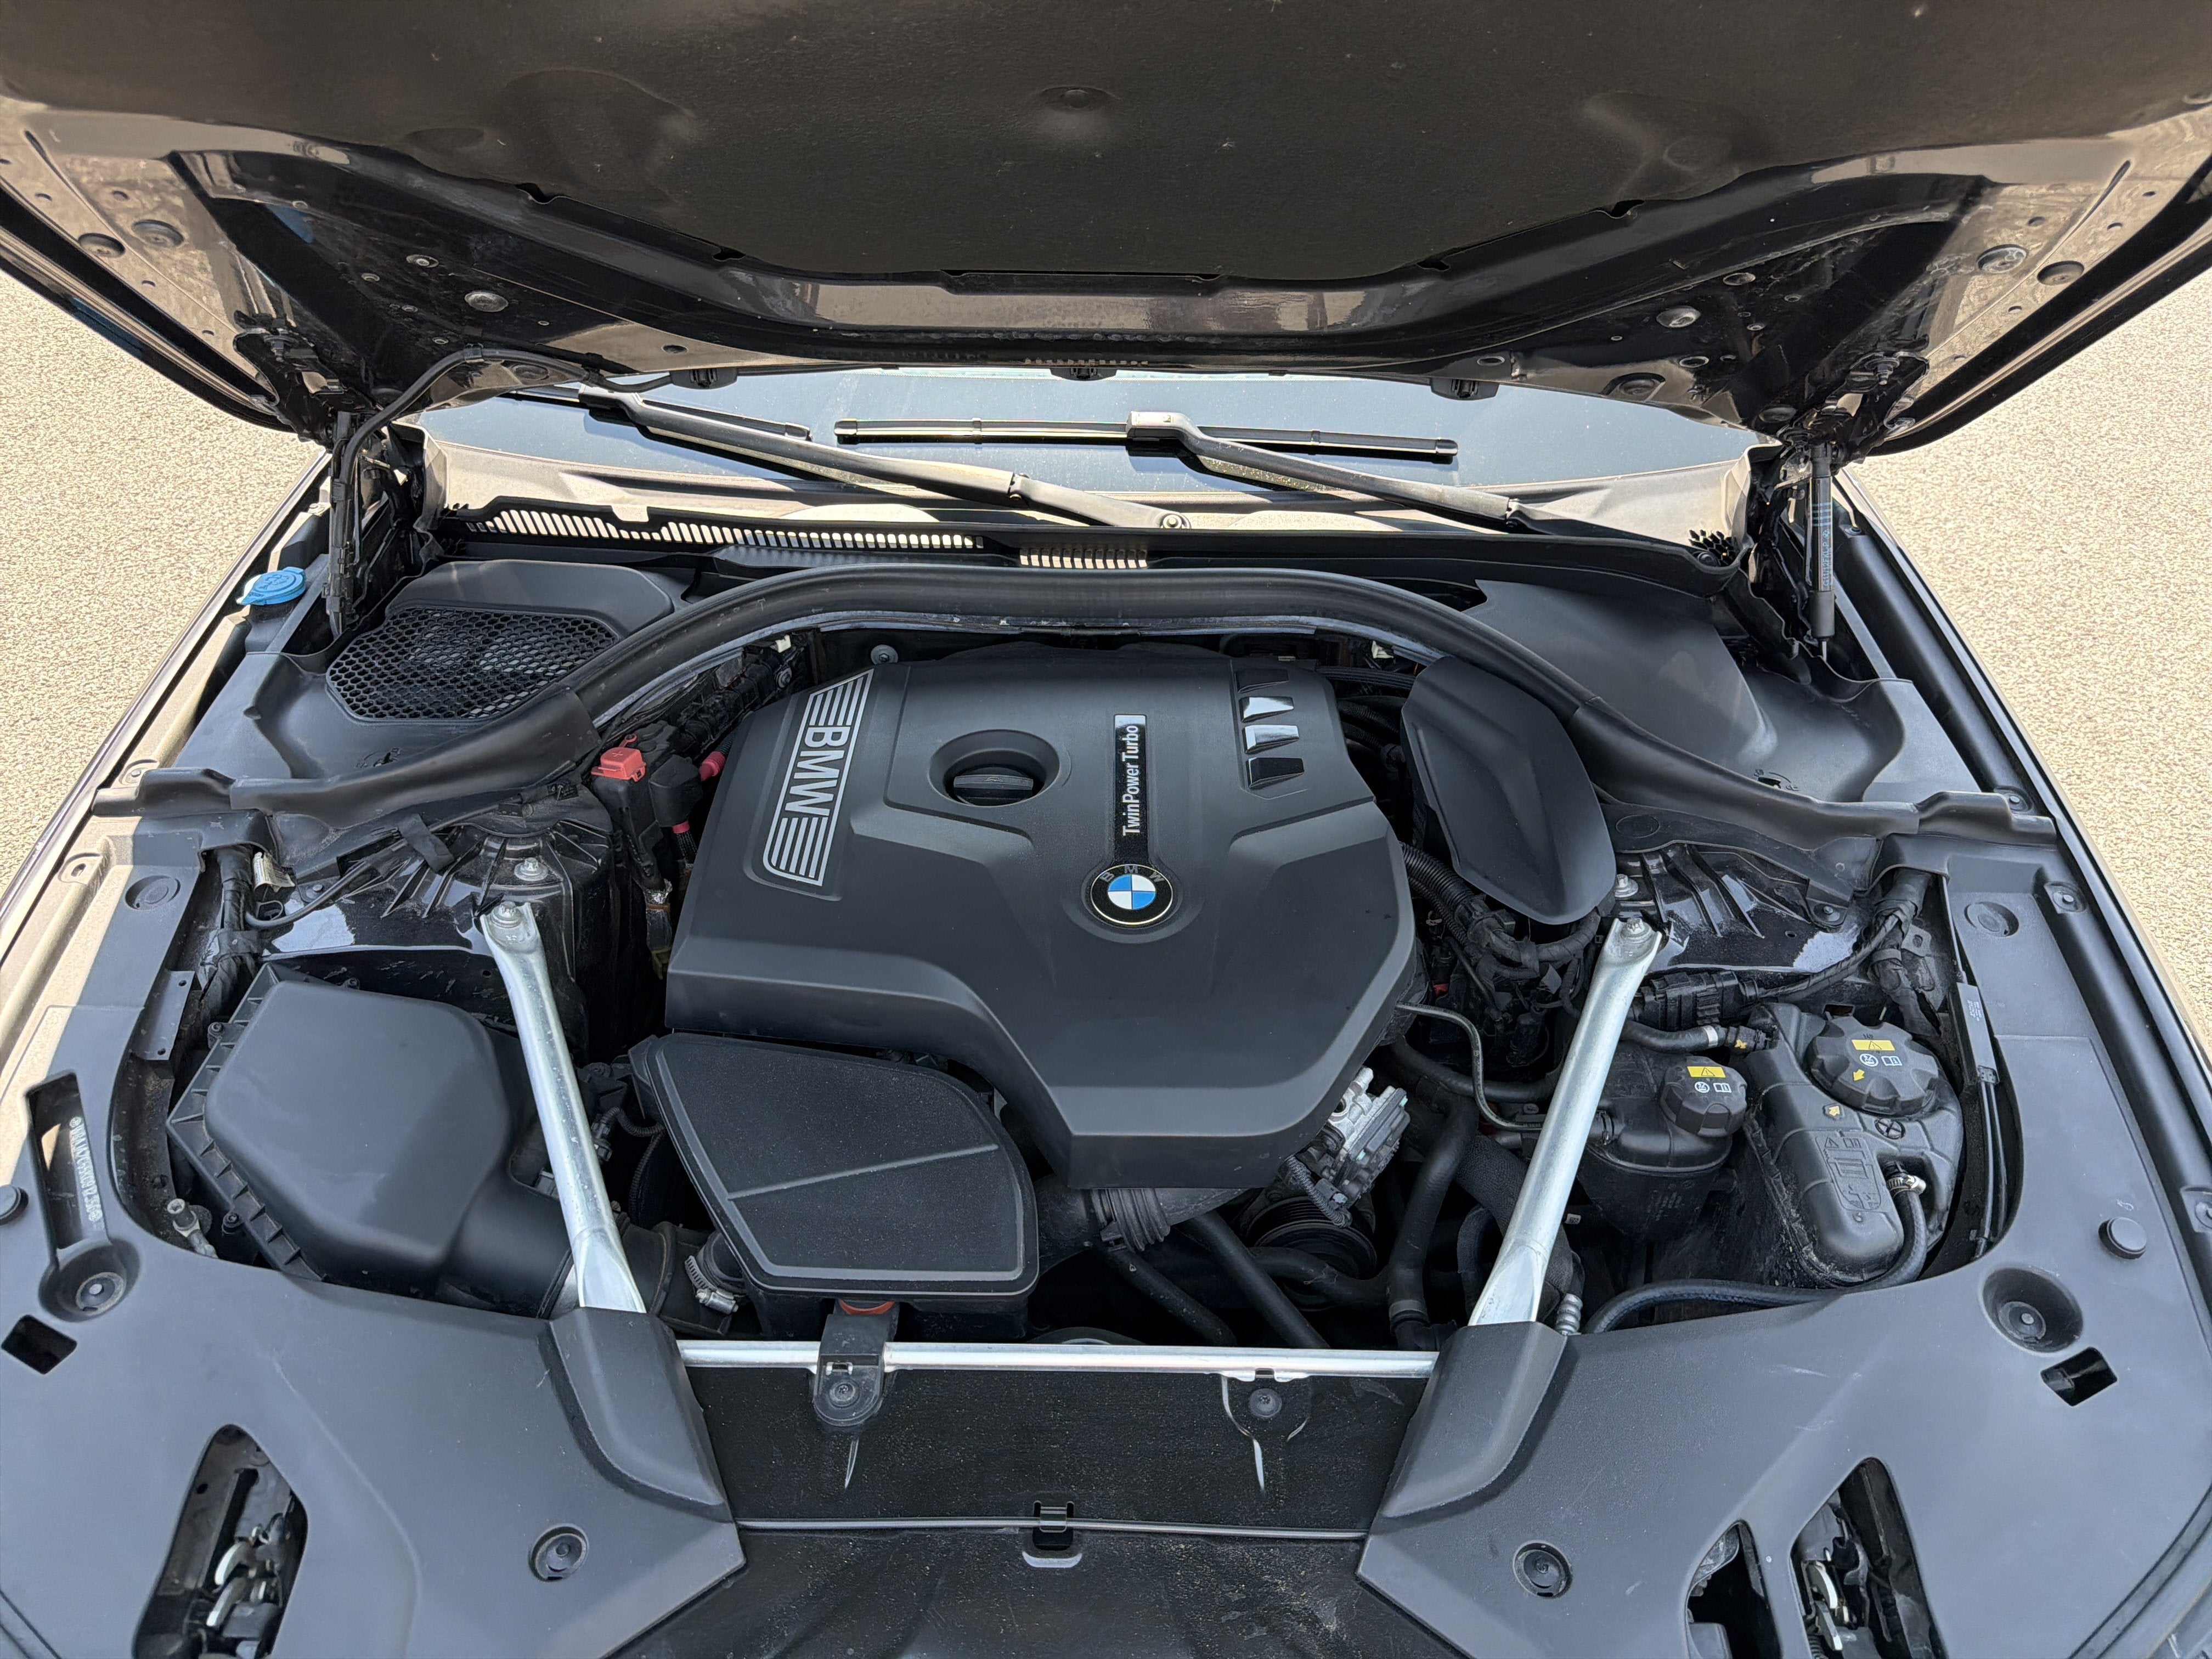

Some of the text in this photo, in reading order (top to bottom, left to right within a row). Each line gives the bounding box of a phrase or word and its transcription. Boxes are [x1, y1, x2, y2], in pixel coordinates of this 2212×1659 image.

[785, 727, 851, 816] BMW
[1122, 725, 1140, 836] TwinPower Turbo
[1100, 866, 1165, 882] BMW
